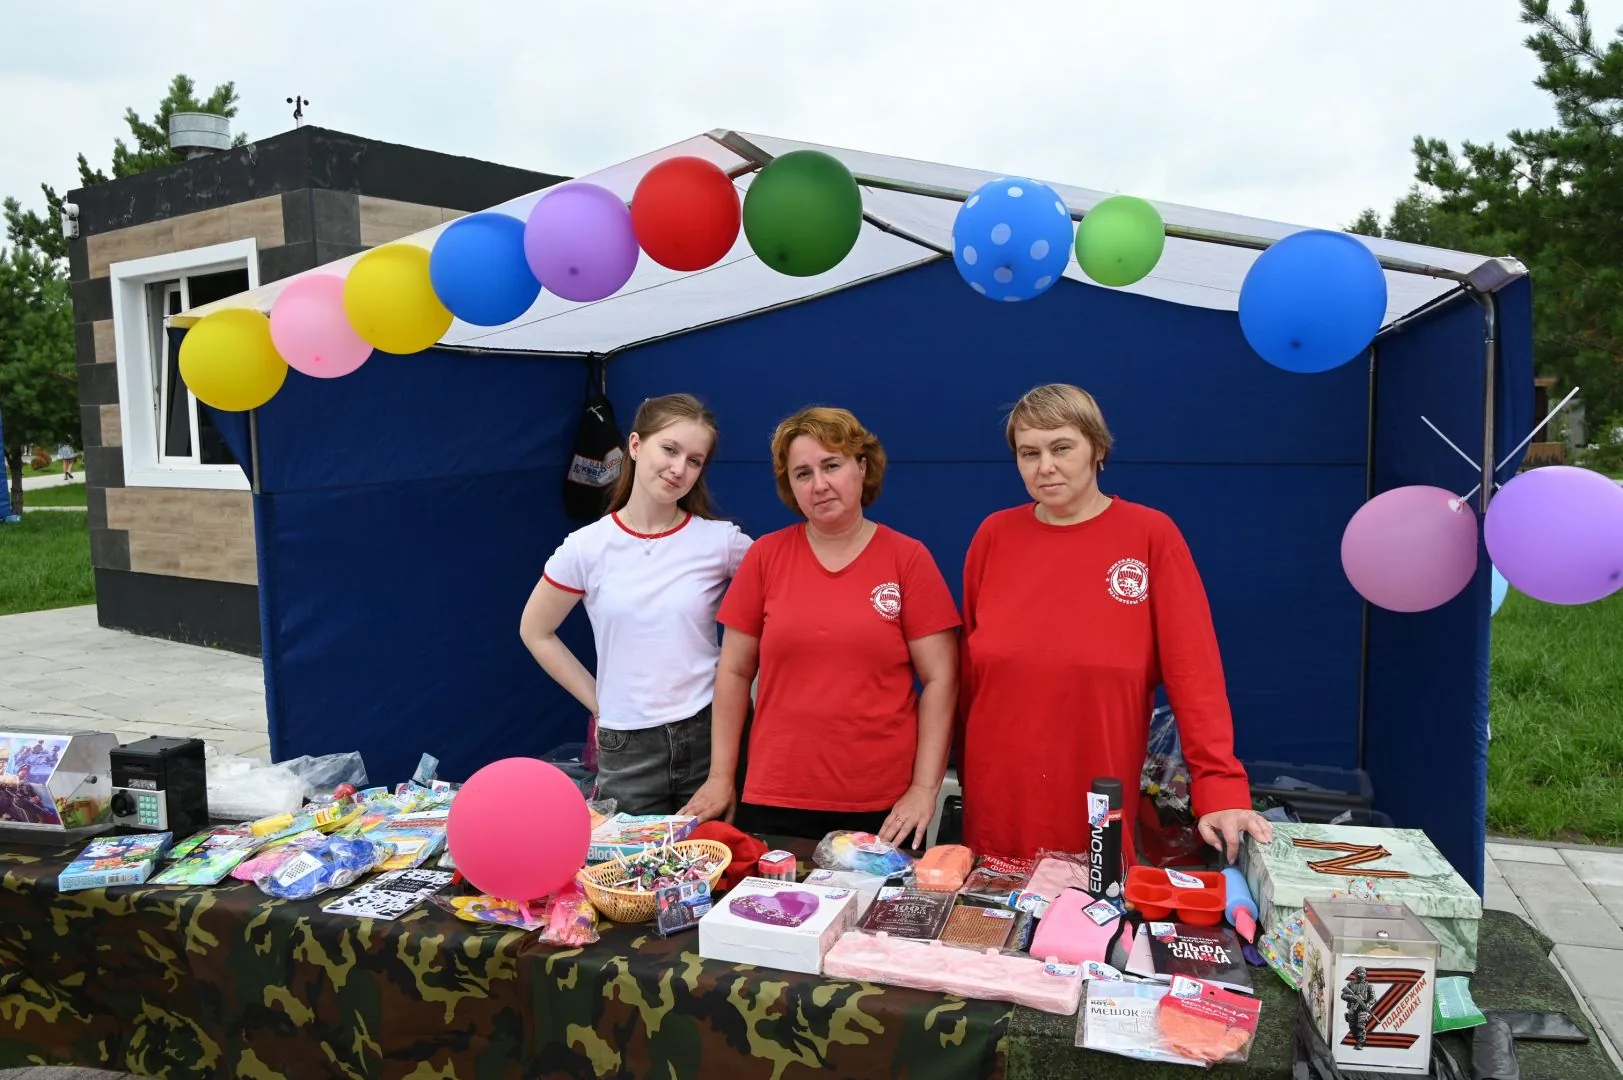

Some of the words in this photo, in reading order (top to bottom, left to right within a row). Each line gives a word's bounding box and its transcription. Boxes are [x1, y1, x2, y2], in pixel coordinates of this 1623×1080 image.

[1090, 825, 1104, 893] EDISON
[1091, 1007, 1139, 1017] МЕШОК
[1381, 977, 1427, 1031] ПОДДЕРЖИМ
[1393, 996, 1422, 1032] НАШИХ!
